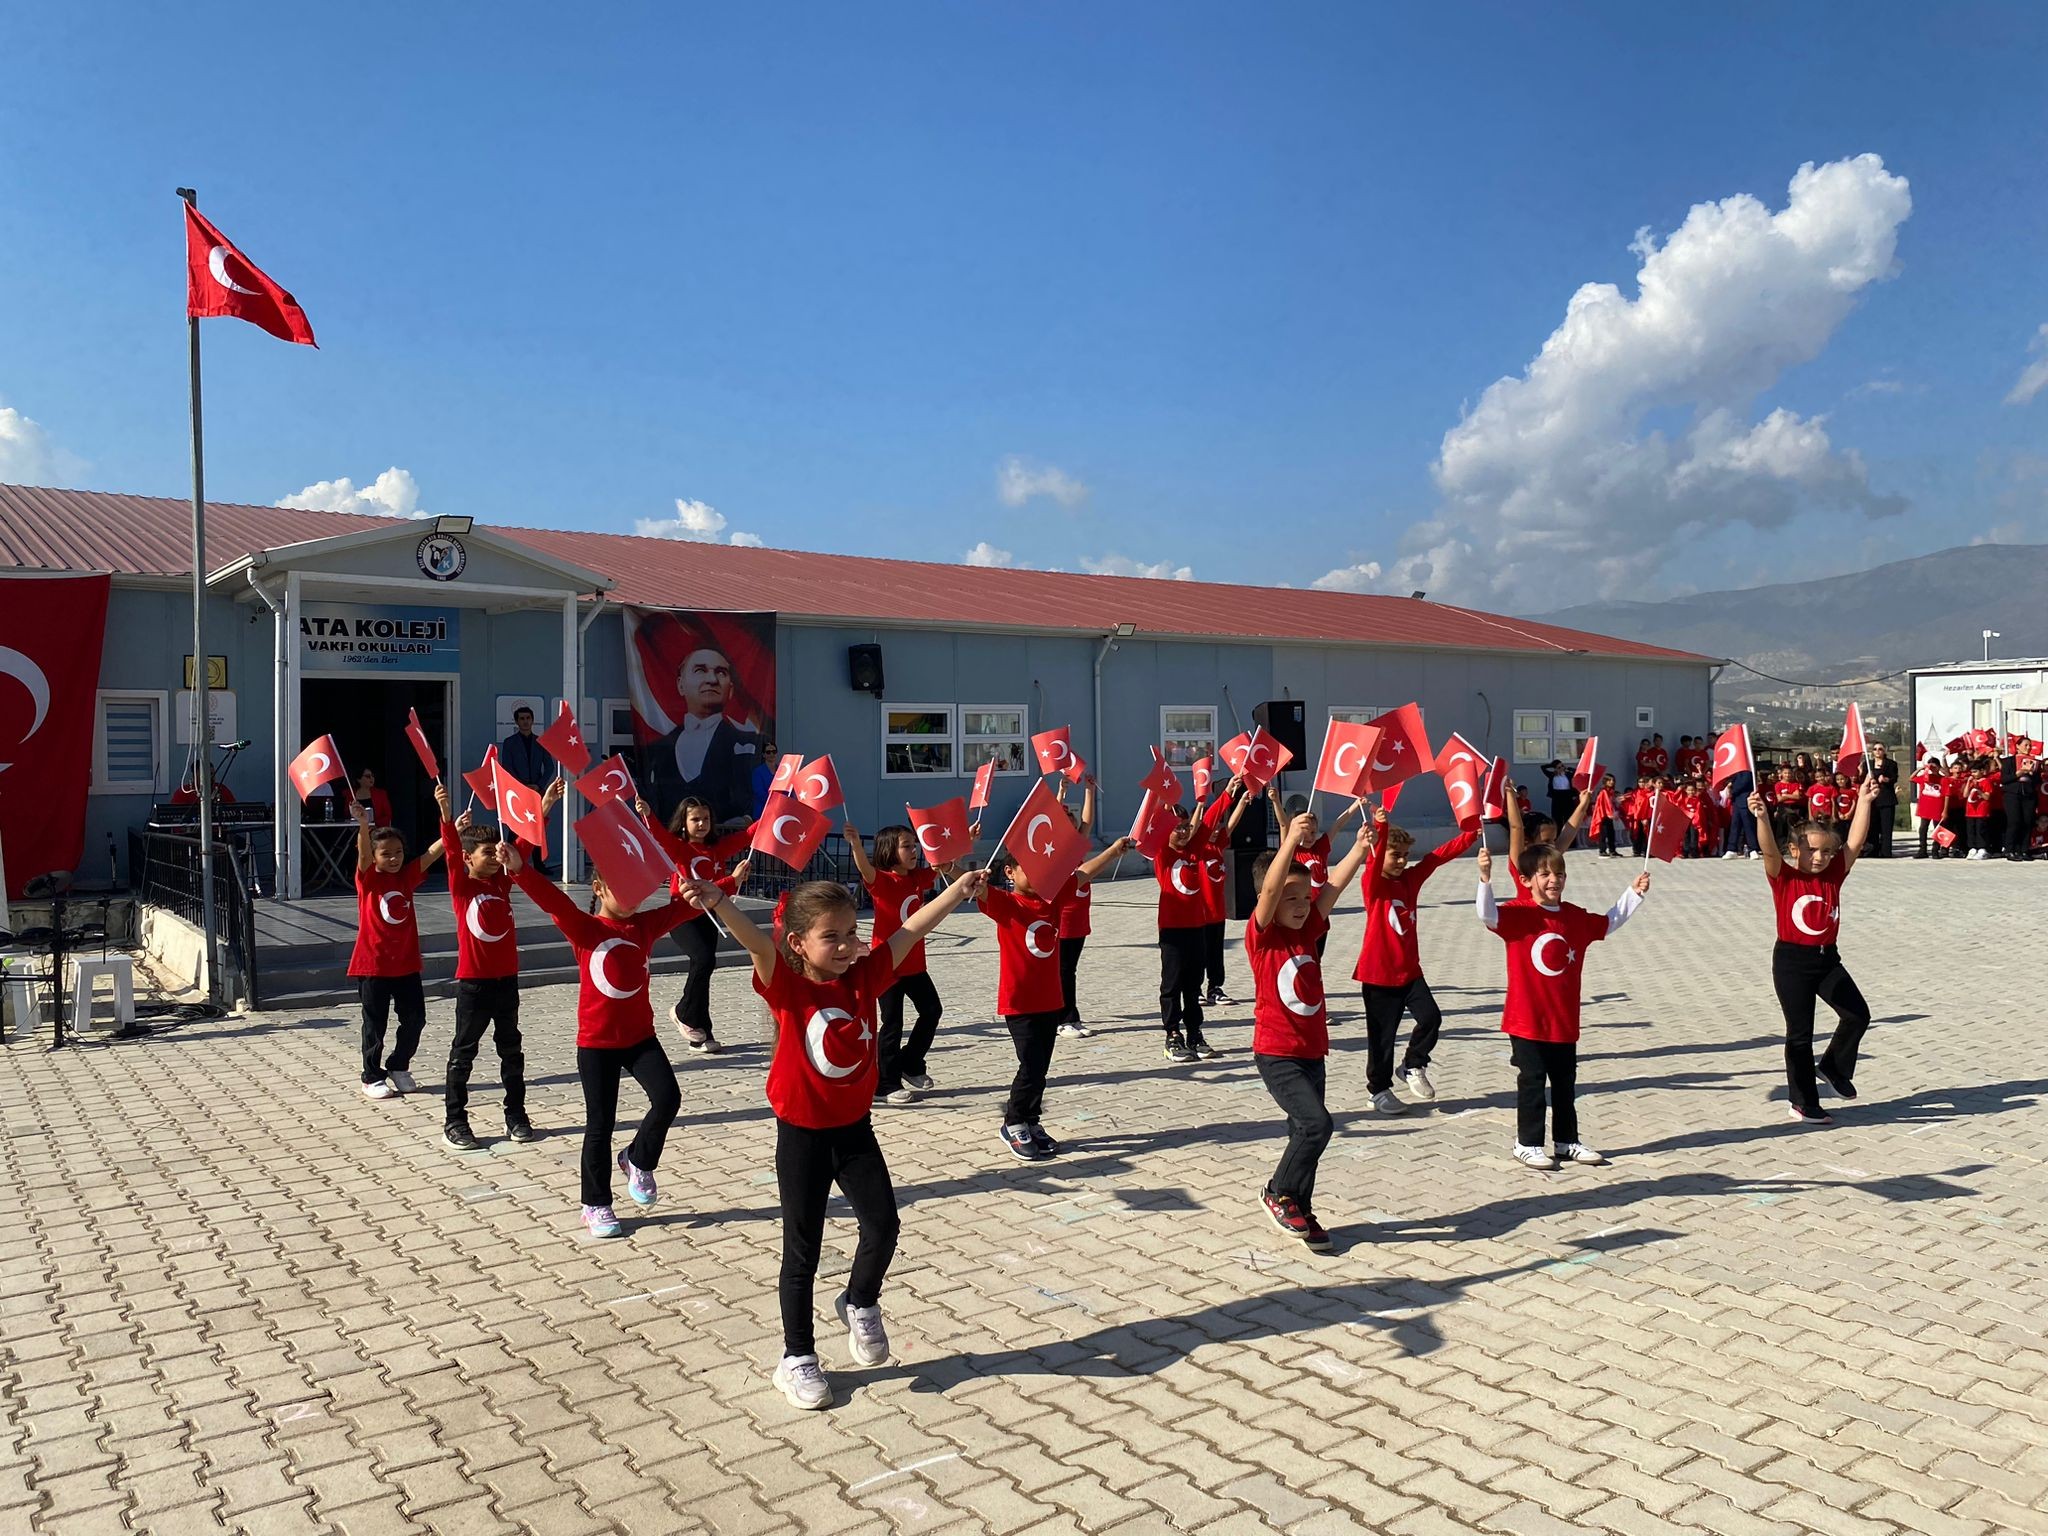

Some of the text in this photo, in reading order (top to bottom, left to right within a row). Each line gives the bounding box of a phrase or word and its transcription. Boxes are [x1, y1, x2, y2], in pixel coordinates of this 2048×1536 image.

[300, 617, 446, 640] ATA KOLEJİ
[307, 640, 432, 655] VAKFI OKULLARI
[381, 655, 399, 664] Beri
